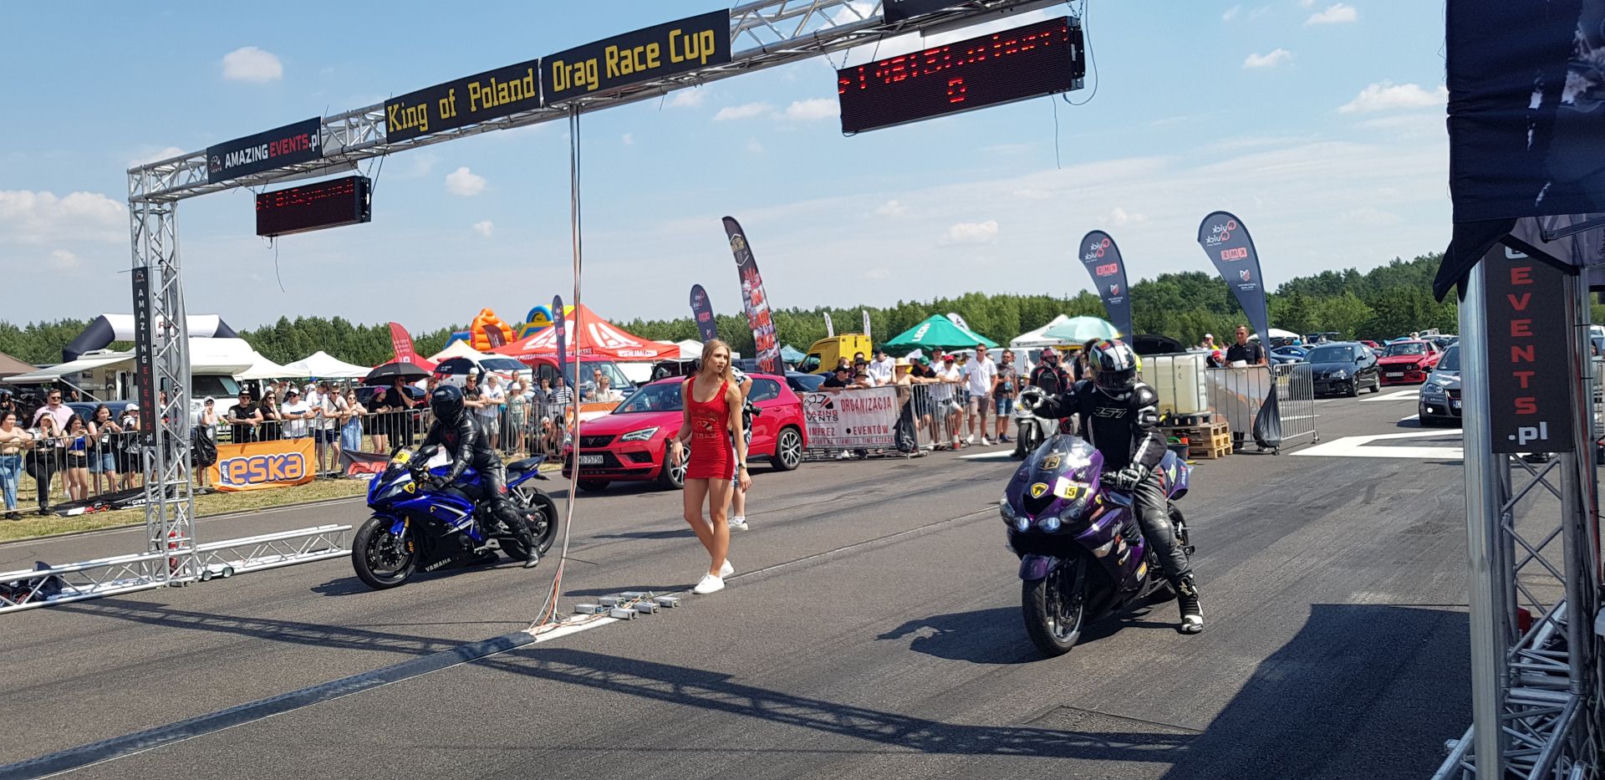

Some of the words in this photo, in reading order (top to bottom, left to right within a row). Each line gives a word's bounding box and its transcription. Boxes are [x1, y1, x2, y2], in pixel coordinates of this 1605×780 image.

[552, 57, 599, 92] Drag
[605, 44, 661, 79] Race
[669, 28, 715, 65] Cup
[387, 104, 429, 132] King
[439, 89, 457, 119] of
[468, 68, 536, 112] Poland
[225, 144, 269, 168] AMAZING
[138, 288, 148, 364] AMAZING
[1506, 266, 1538, 415] EVENTS
[142, 366, 151, 430] EVENTS
[840, 396, 892, 414] ORGANIZACJA
[808, 427, 835, 436] IMPREZ
[1508, 422, 1548, 445] .pl
[229, 454, 303, 485] eska
[425, 557, 452, 573] YAMAHA
